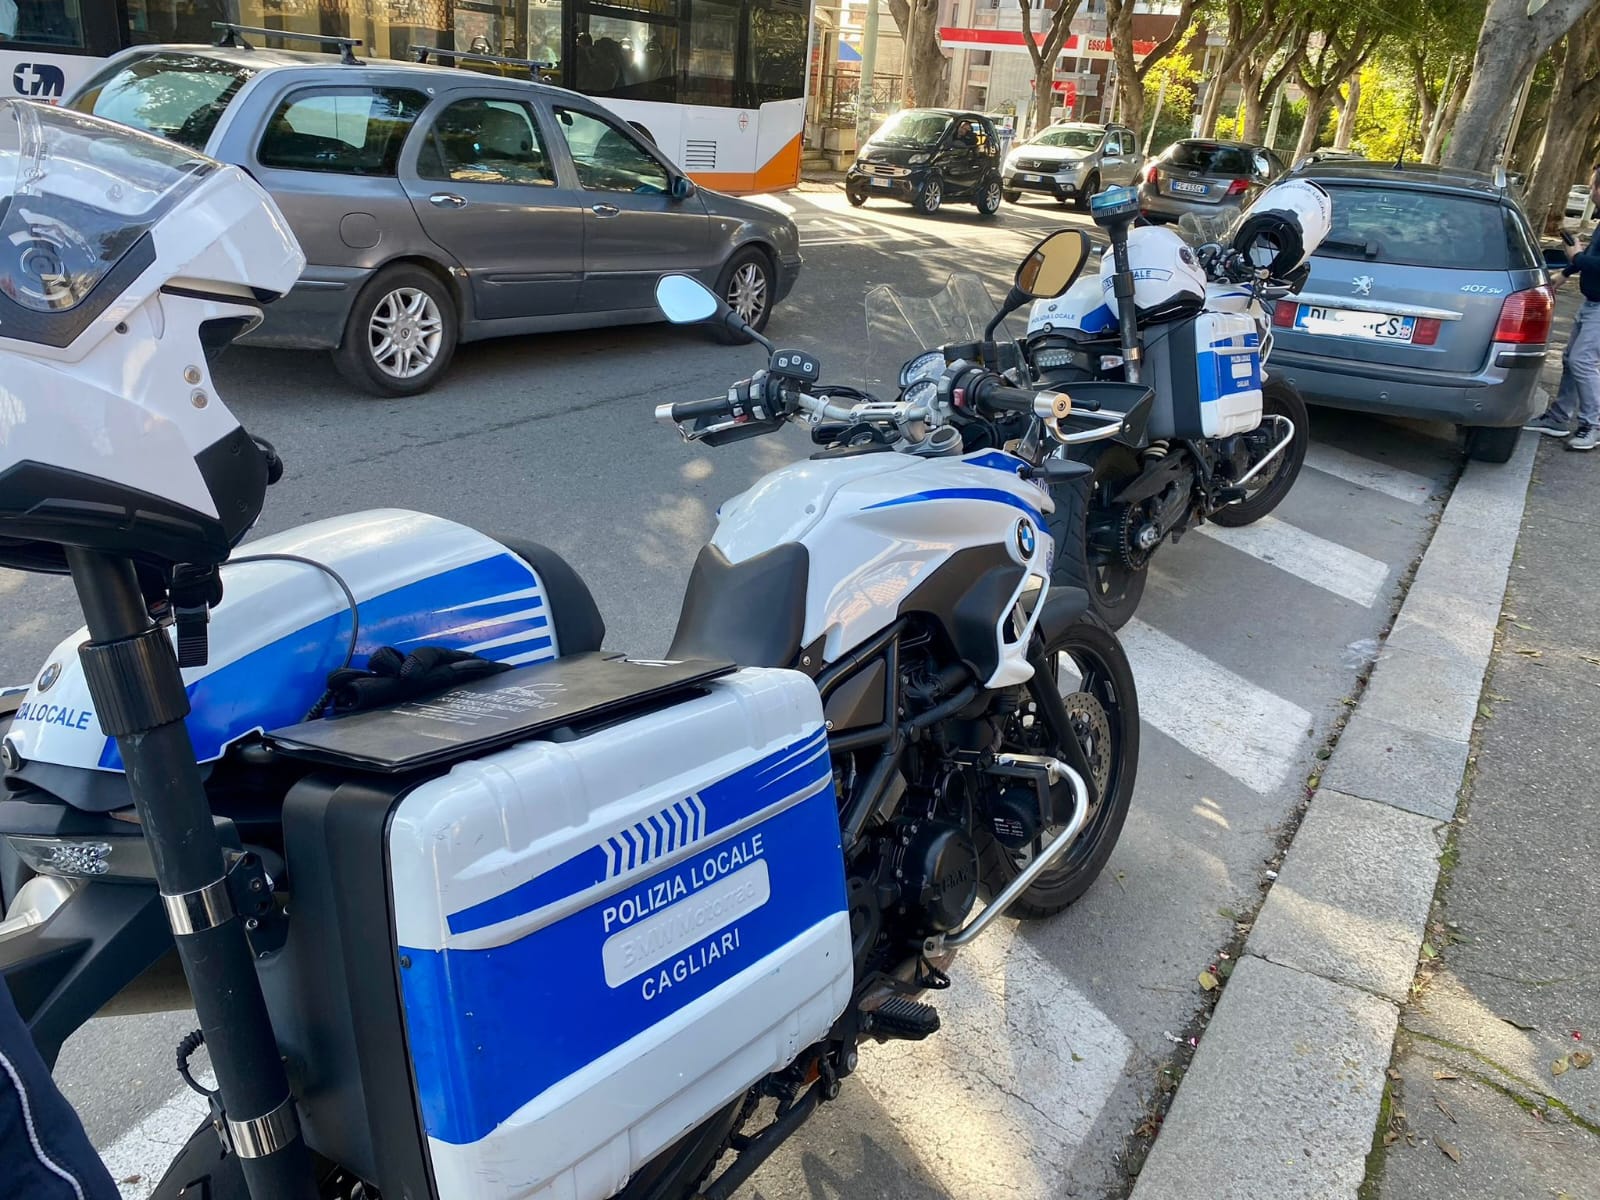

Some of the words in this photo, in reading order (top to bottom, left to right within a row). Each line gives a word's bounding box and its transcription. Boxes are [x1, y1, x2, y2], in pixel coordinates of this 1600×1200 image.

[1088, 39, 1106, 51] ESSO
[1460, 284, 1488, 293] 407
[1051, 313, 1076, 321] LOCALE
[29, 703, 92, 730] LOCALE
[602, 874, 687, 933] POLIZIA
[691, 834, 764, 889] LOCALE
[641, 927, 741, 1001] CAGLIARI
